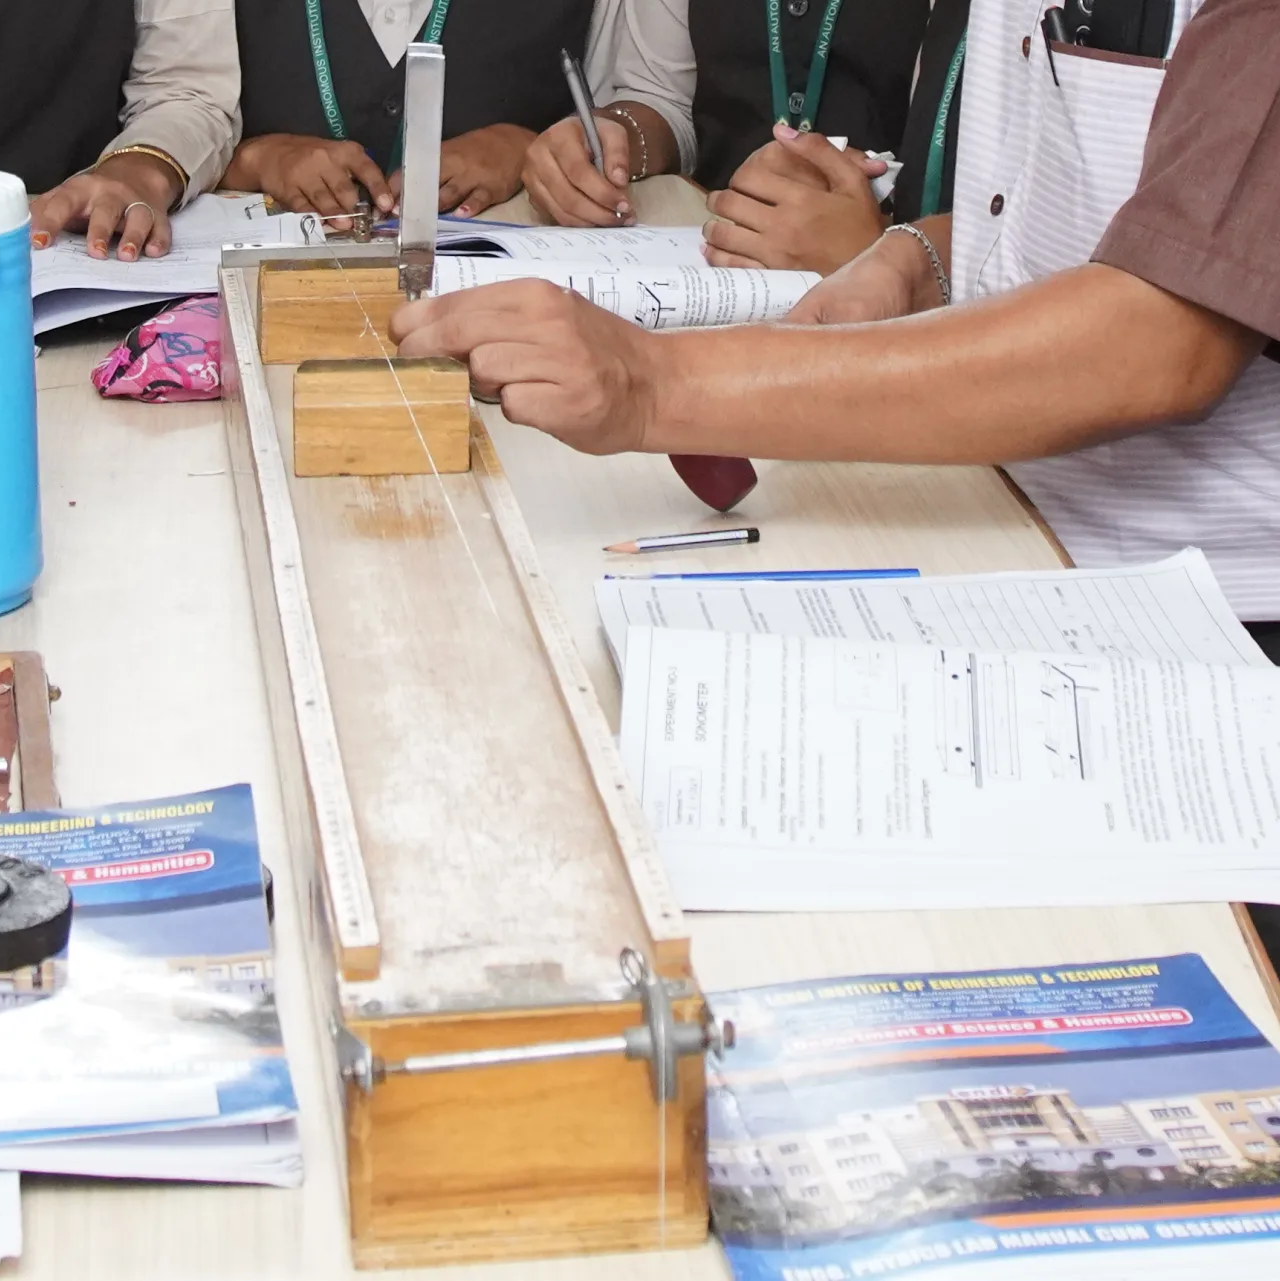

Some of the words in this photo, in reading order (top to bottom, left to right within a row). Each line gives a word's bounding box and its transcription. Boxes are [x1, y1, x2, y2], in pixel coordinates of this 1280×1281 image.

[772, 36, 780, 53] AN
[817, 41, 829, 58] AN
[316, 59, 344, 137] AUTONOMOUS
[935, 128, 944, 147] AN
[664, 688, 676, 741] EXPERIMENT
[695, 683, 708, 741] SONOMETER
[101, 815, 112, 825] &
[117, 800, 214, 823] TECHNOLOGY
[73, 870, 87, 880] &
[95, 855, 206, 879] Humanities
[905, 980, 925, 992] OF
[930, 973, 1039, 991] ENGINEERING
[1043, 973, 1055, 984] &
[1059, 963, 1160, 982] TECHNOLOGY
[925, 1023, 944, 1036] of
[953, 1020, 1036, 1035] Science
[1042, 1018, 1059, 1030] &
[1065, 1010, 1183, 1030] Humanities
[1000, 1226, 1093, 1250] MANUAL
[1096, 1222, 1149, 1243] CUM
